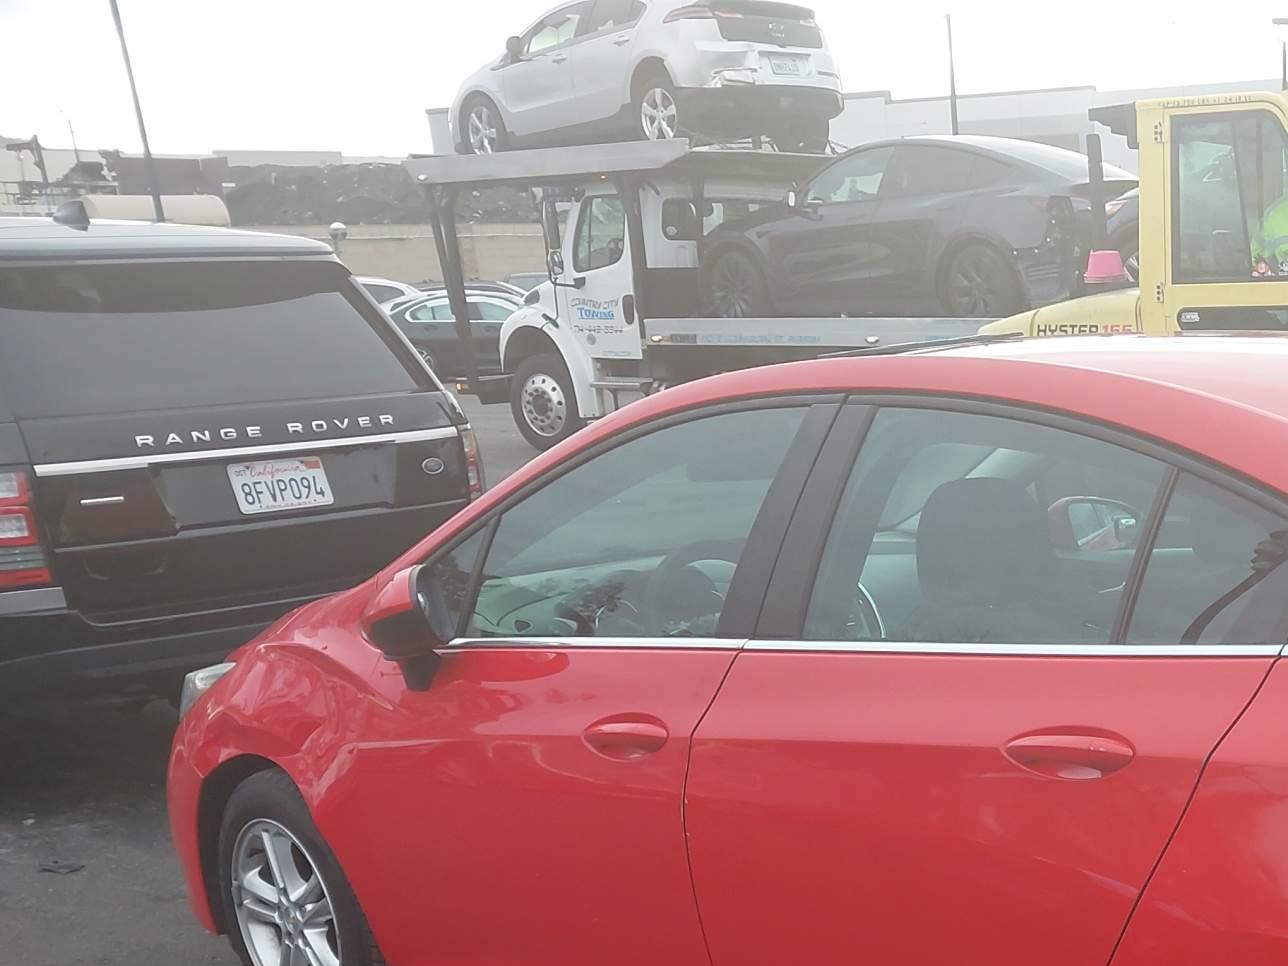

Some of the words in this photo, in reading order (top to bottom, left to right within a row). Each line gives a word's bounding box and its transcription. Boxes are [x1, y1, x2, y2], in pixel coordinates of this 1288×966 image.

[135, 426, 263, 447] RANGE
[287, 414, 395, 435] ROVER
[241, 475, 326, 505] 8FVP094
